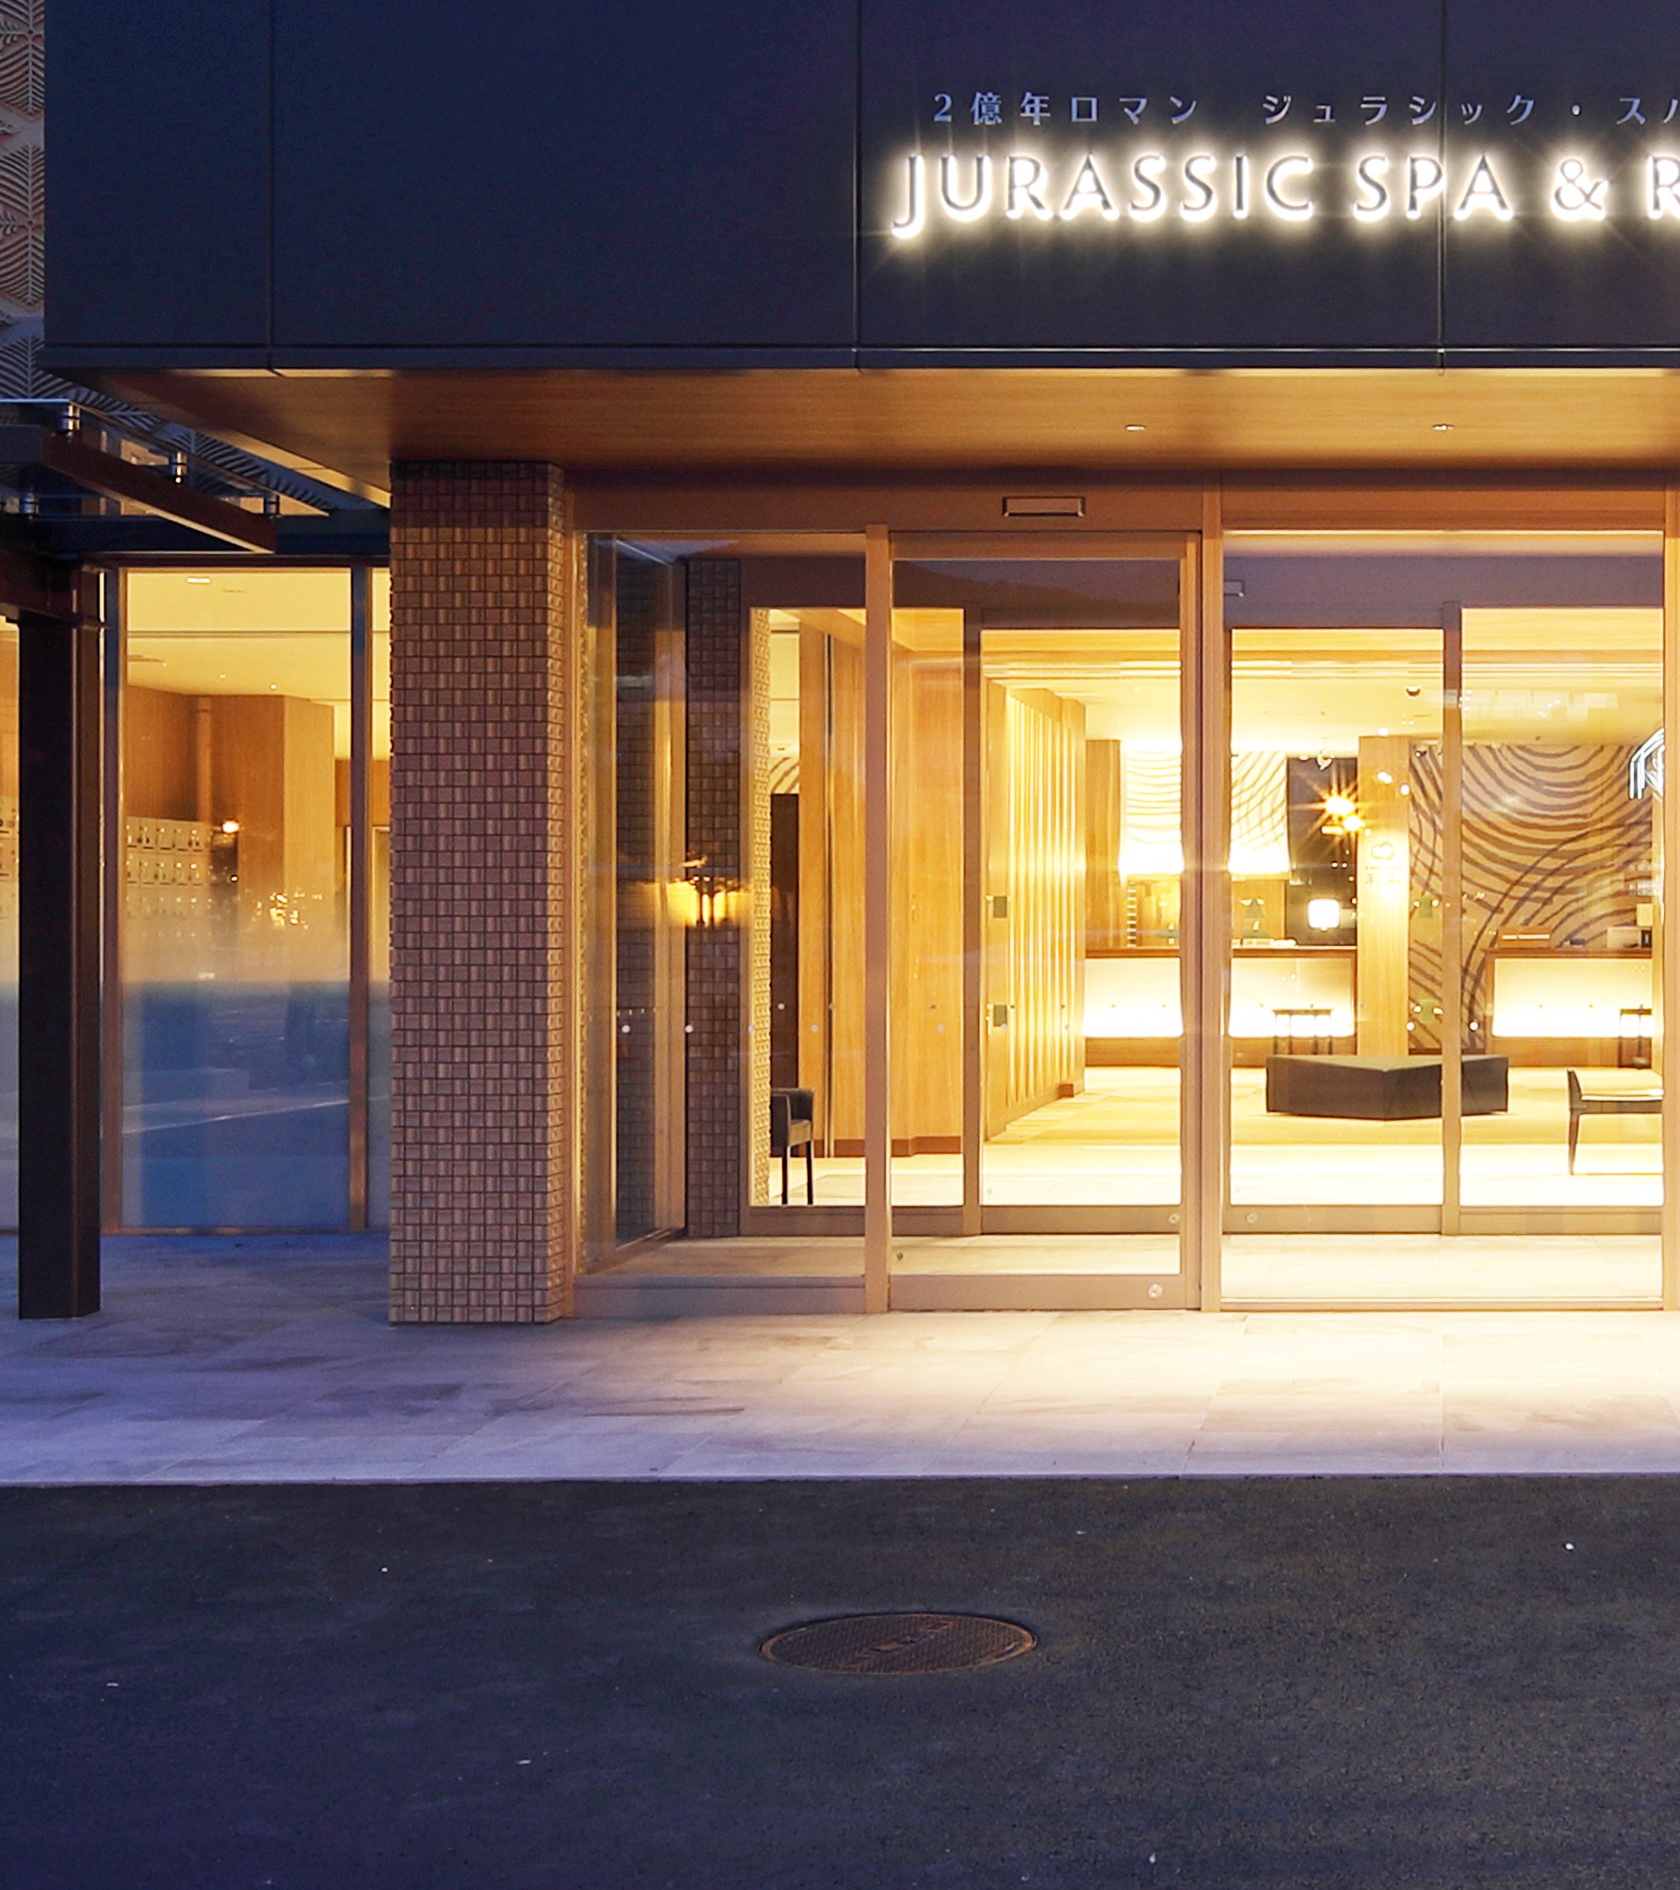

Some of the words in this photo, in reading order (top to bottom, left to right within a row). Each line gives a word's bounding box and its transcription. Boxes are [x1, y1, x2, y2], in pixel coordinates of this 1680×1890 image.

[892, 153, 1314, 238] JURASSIC
[1354, 153, 1515, 221] SPA
[1549, 157, 1609, 221] &
